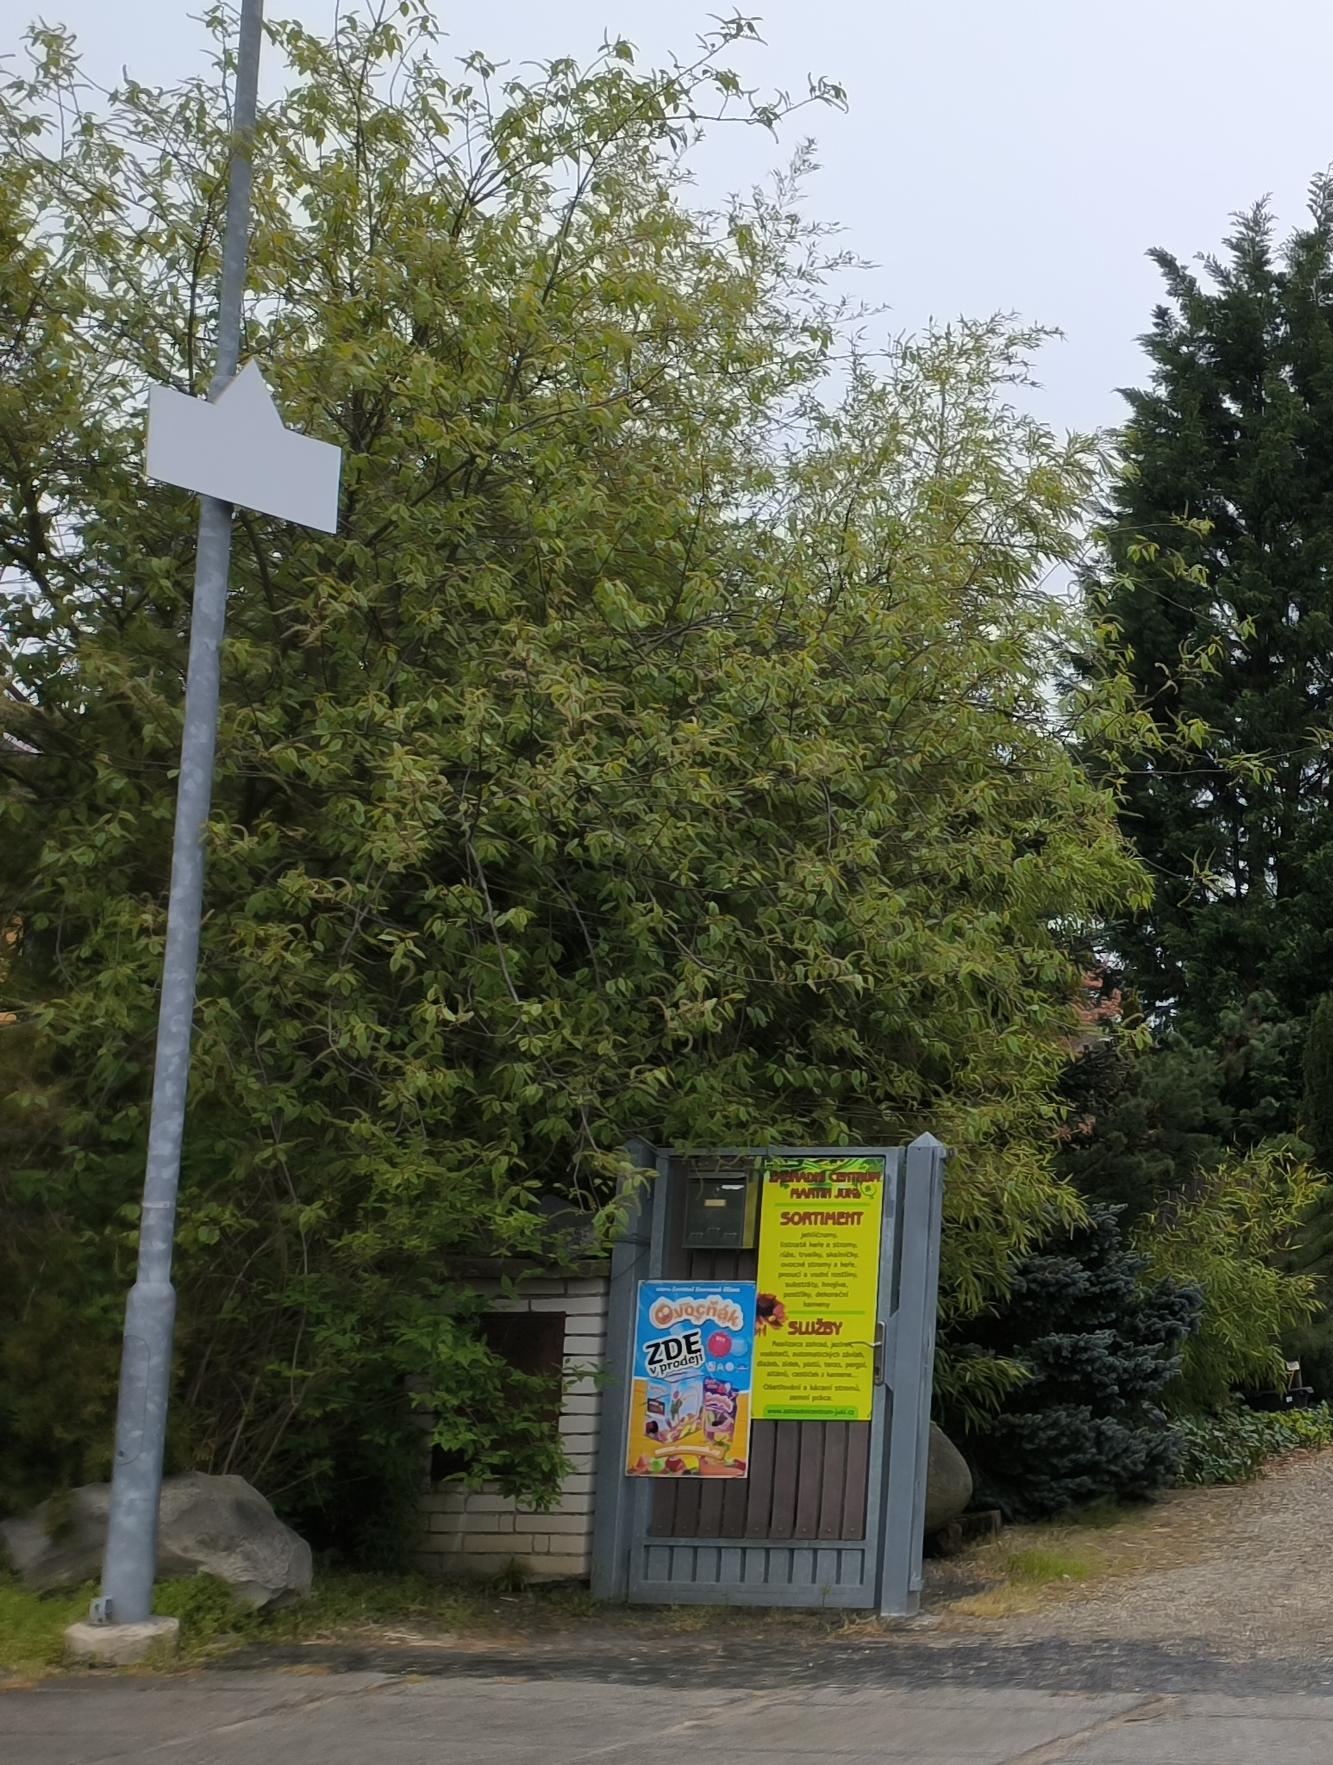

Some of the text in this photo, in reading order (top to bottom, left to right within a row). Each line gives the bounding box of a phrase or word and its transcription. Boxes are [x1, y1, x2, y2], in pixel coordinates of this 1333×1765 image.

[779, 1211, 865, 1226] SORTIMENT
[654, 1299, 740, 1327] Ovocňák
[788, 1318, 843, 1335] SLUŽBY
[646, 1331, 702, 1365] ZDE
[650, 1354, 704, 1375] v prodeji
